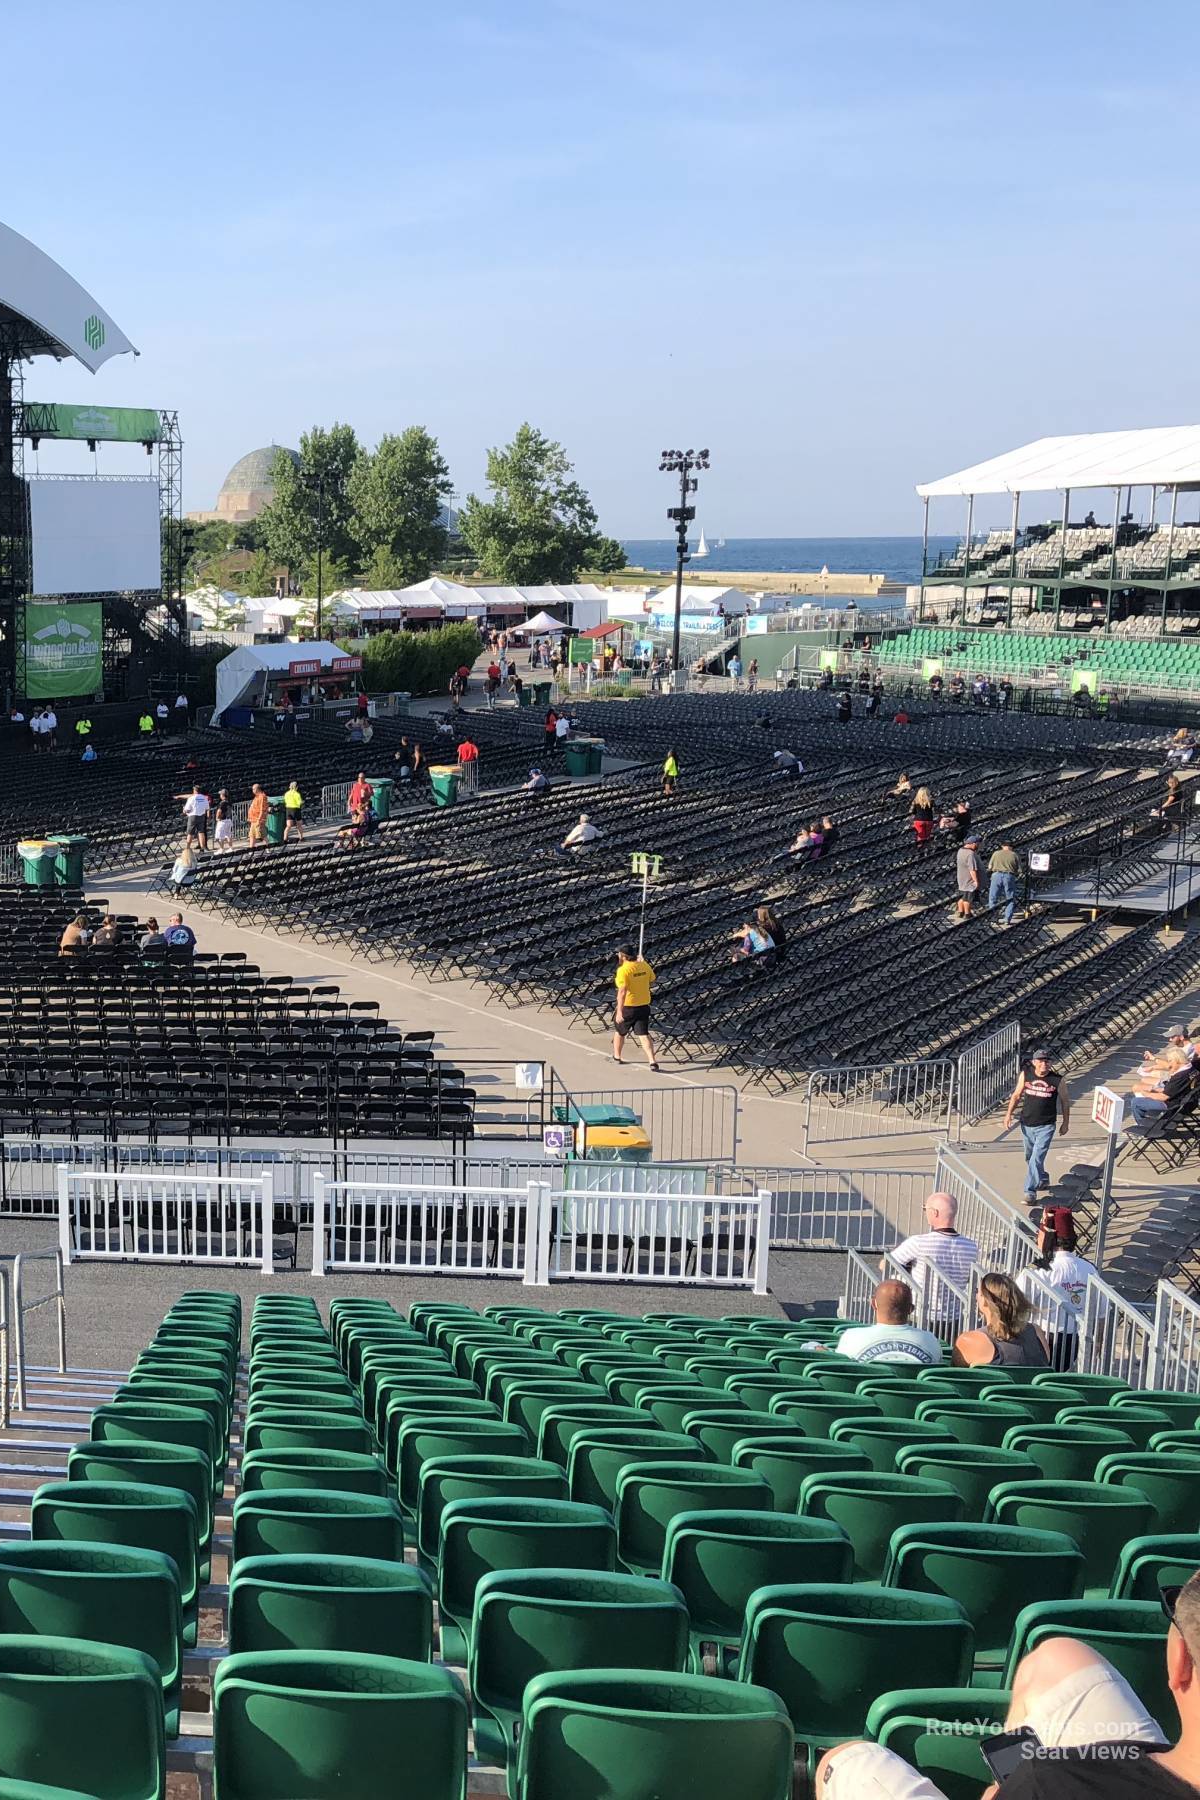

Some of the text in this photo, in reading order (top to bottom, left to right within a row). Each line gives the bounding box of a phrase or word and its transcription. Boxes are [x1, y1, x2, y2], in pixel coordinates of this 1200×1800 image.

[78, 638, 99, 655] Bank
[1097, 1091, 1114, 1120] EXIT
[859, 1343, 900, 1363] MERICAN
